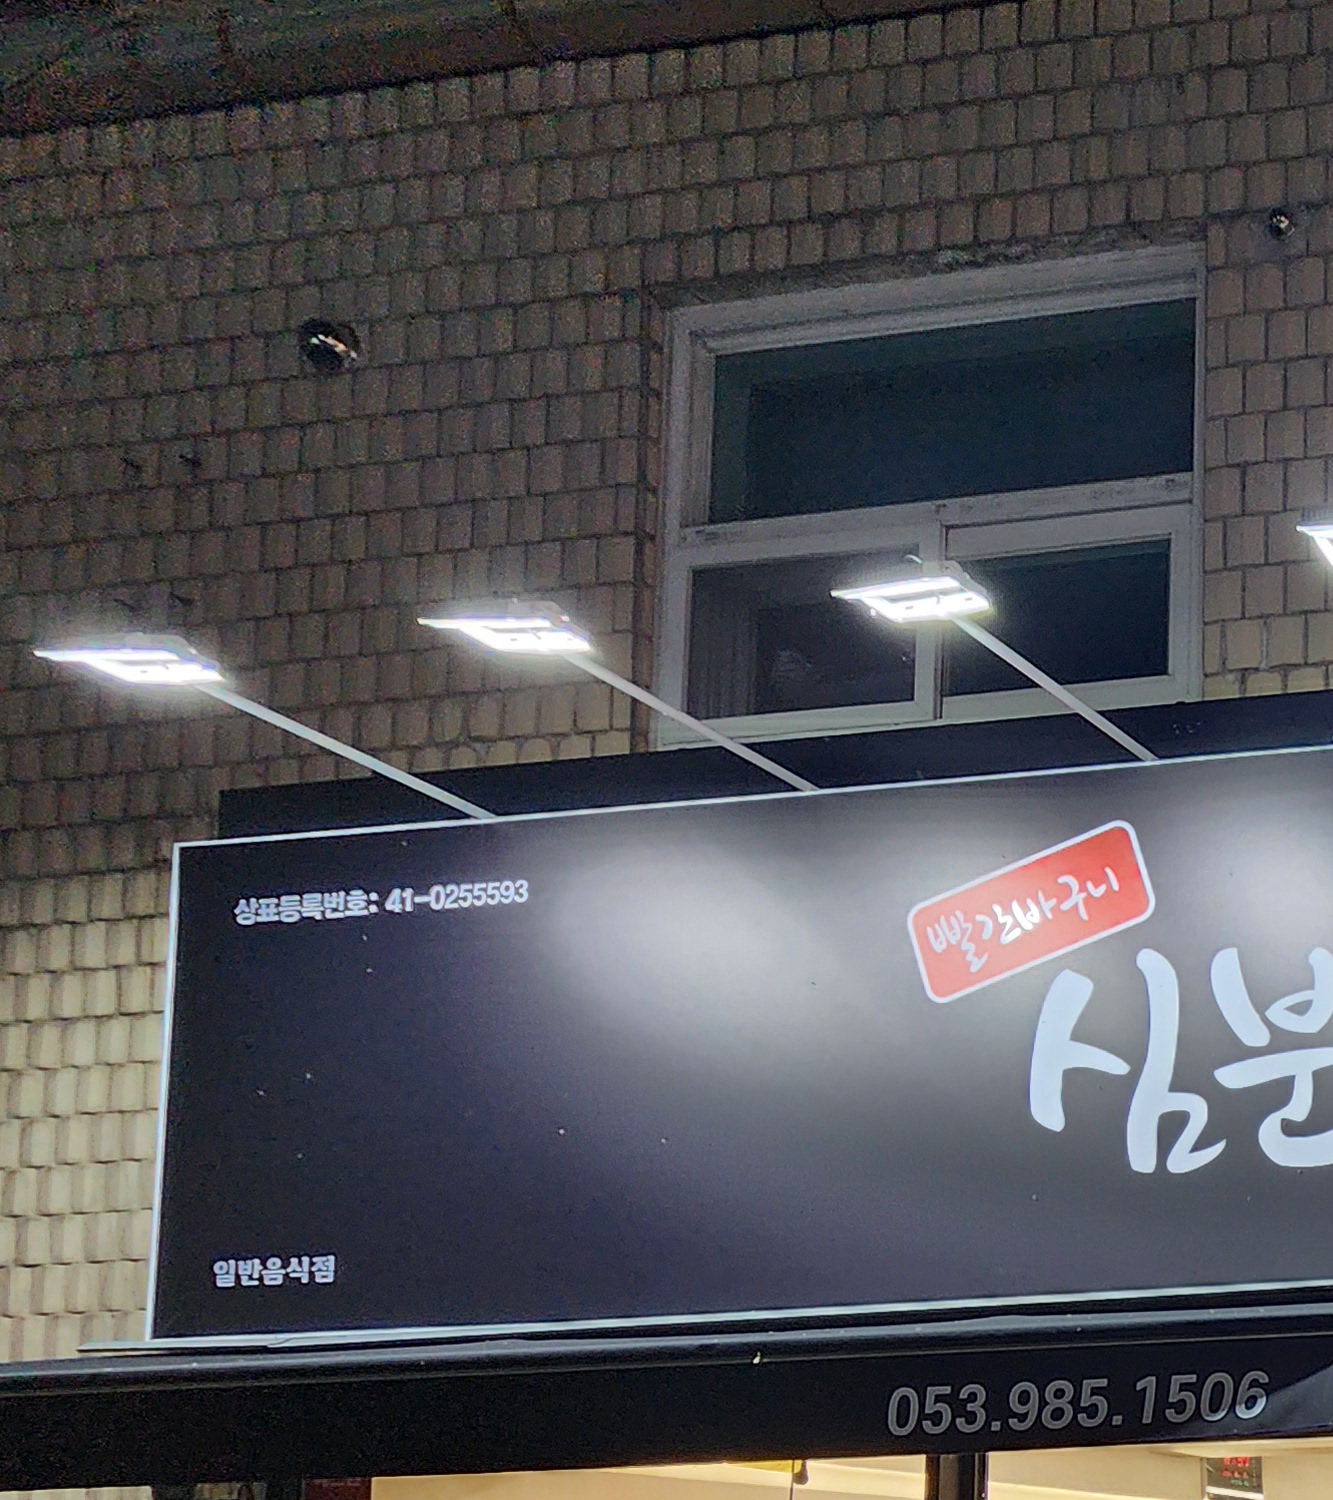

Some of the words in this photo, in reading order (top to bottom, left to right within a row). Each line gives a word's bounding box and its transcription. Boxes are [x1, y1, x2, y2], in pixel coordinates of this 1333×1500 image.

[234, 889, 379, 926] 상표등록번호:
[384, 879, 530, 913] 41-0255593
[926, 866, 1120, 974] 빨간바구니
[212, 1254, 336, 1289] 일반음식점
[887, 1370, 1271, 1437] 053.985.1506
